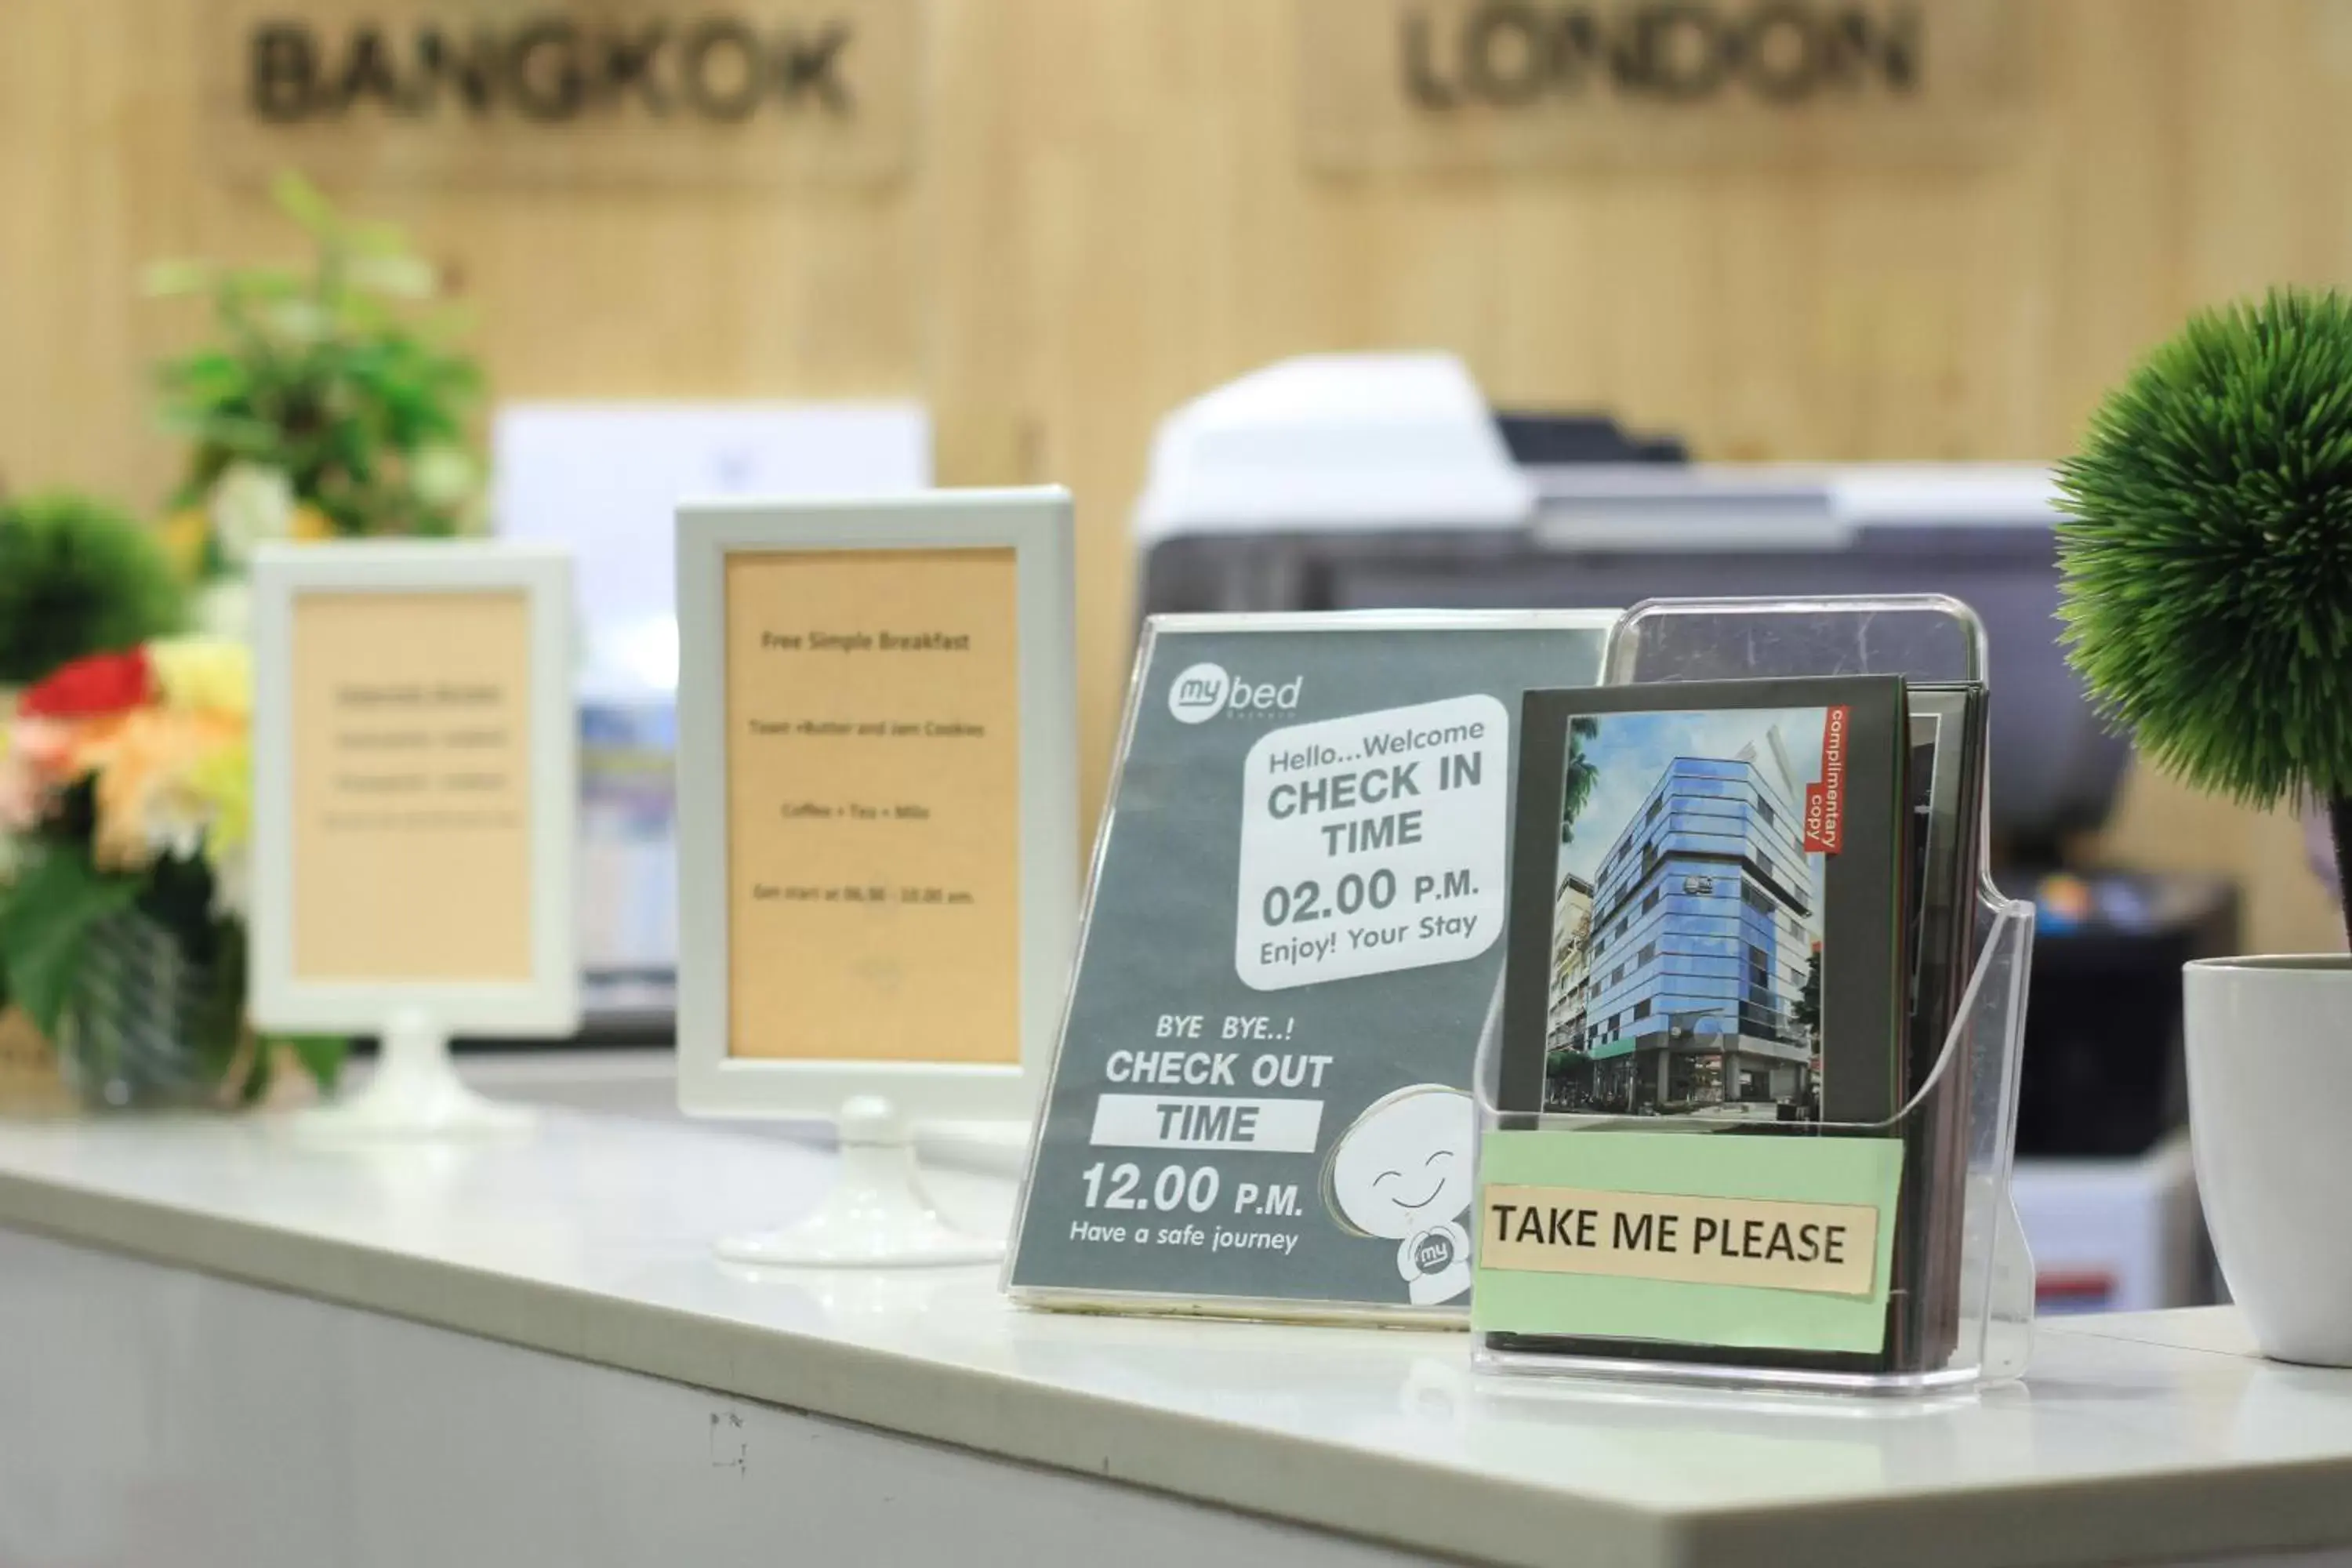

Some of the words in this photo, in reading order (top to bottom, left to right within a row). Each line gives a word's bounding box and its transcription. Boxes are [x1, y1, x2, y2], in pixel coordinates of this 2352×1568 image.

[249, 20, 856, 123] BANGKOK
[1400, 0, 1926, 108] LONDON
[761, 630, 801, 651] Free
[808, 630, 873, 654] Simple
[879, 630, 970, 652] Breakfast
[1268, 760, 1421, 820] CHECK
[1439, 751, 1483, 790] IN
[1822, 709, 1843, 848] complimentary
[1321, 810, 1423, 857] TIME
[1806, 794, 1823, 840] copy
[1263, 868, 1397, 927] 02.00
[1414, 869, 1479, 903] P.M.
[1260, 932, 1336, 966] Enjoy!
[1348, 924, 1409, 951] Your
[1418, 915, 1478, 940] Stay
[1156, 1014, 1203, 1039] BYE
[1222, 1016, 1295, 1041] BYE..!
[1105, 1051, 1239, 1086] CHECK
[1251, 1055, 1333, 1088] OUT
[1156, 1104, 1259, 1143] TIME
[1083, 1162, 1220, 1212] 12.00
[1234, 1183, 1303, 1217] P.M.
[1069, 1221, 1126, 1243] Have
[1134, 1229, 1149, 1243] a
[1157, 1224, 1205, 1246] safe
[1212, 1226, 1298, 1255] journey
[1421, 1243, 1448, 1269] my
[1491, 1204, 1599, 1248] TAKE
[1613, 1211, 1679, 1253] ME
[1693, 1217, 1847, 1265] PLEASE
